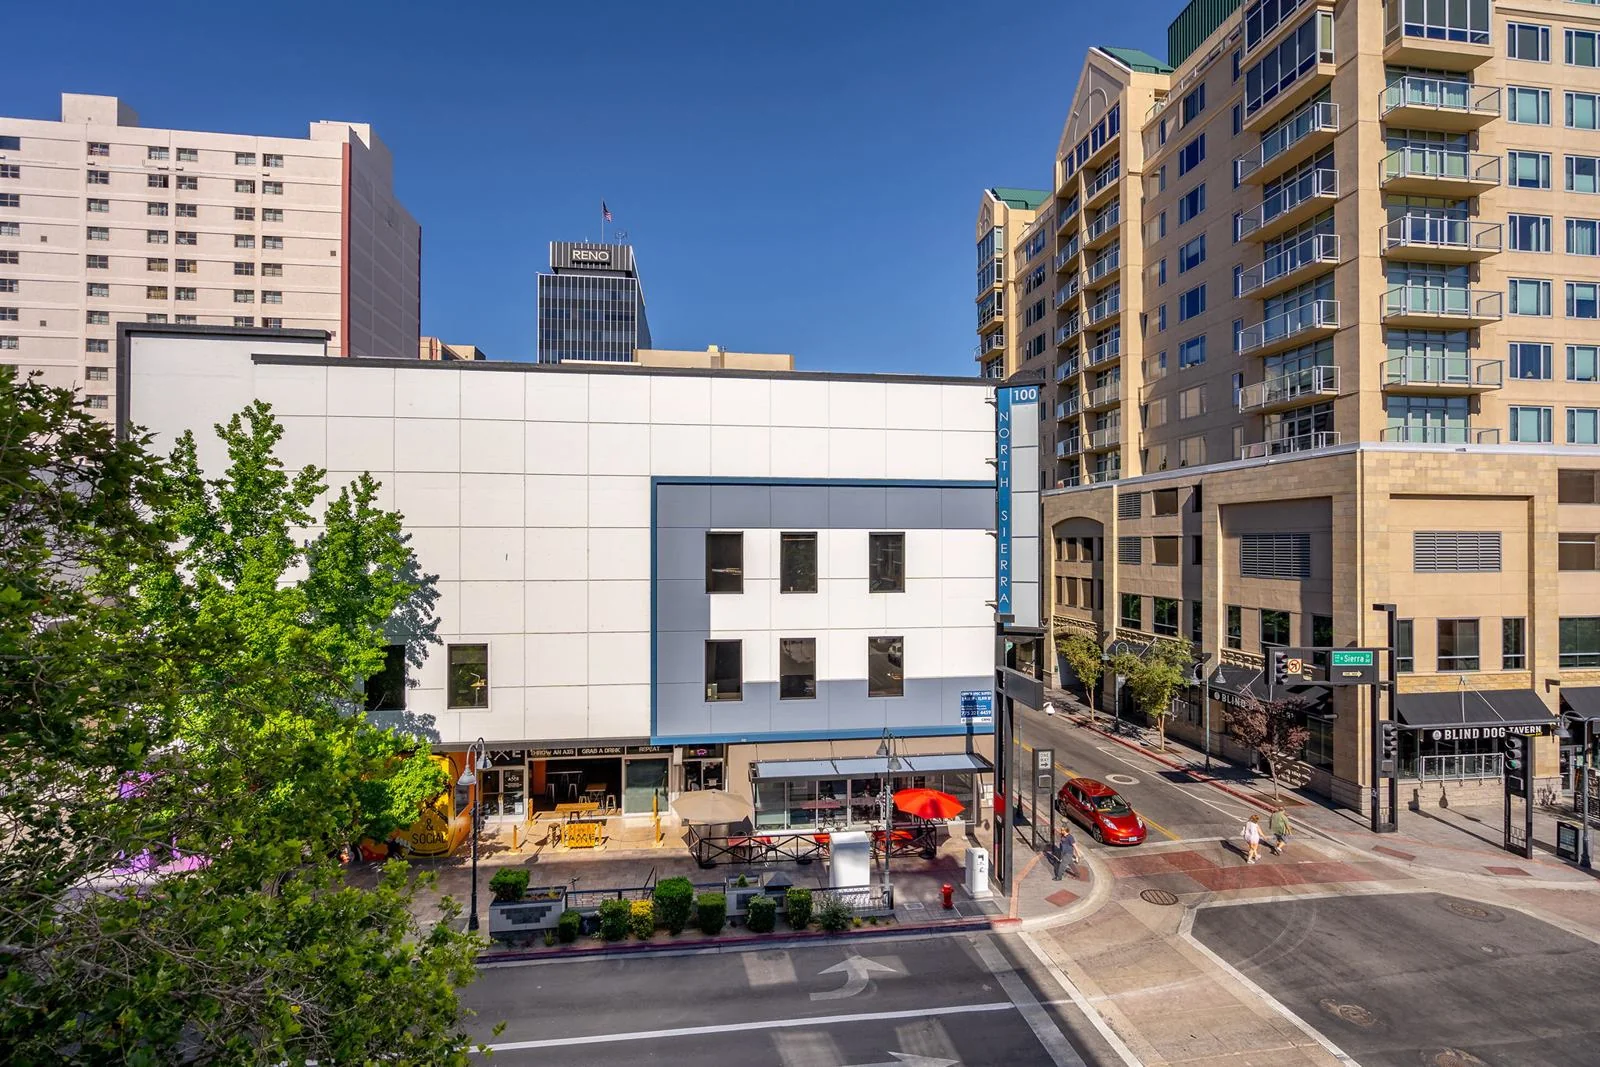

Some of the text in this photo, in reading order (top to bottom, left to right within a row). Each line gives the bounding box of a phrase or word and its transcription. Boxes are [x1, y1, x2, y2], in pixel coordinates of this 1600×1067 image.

[572, 249, 609, 261] RENO
[1013, 388, 1037, 401] 100
[999, 411, 1010, 604] NORTH SIERRA
[1343, 654, 1365, 663] Sierra
[1221, 693, 1246, 708] BLIND
[1444, 725, 1542, 741] BLIND DOG TAVERN
[425, 818, 434, 831] &
[411, 832, 445, 845] SOCIAL
